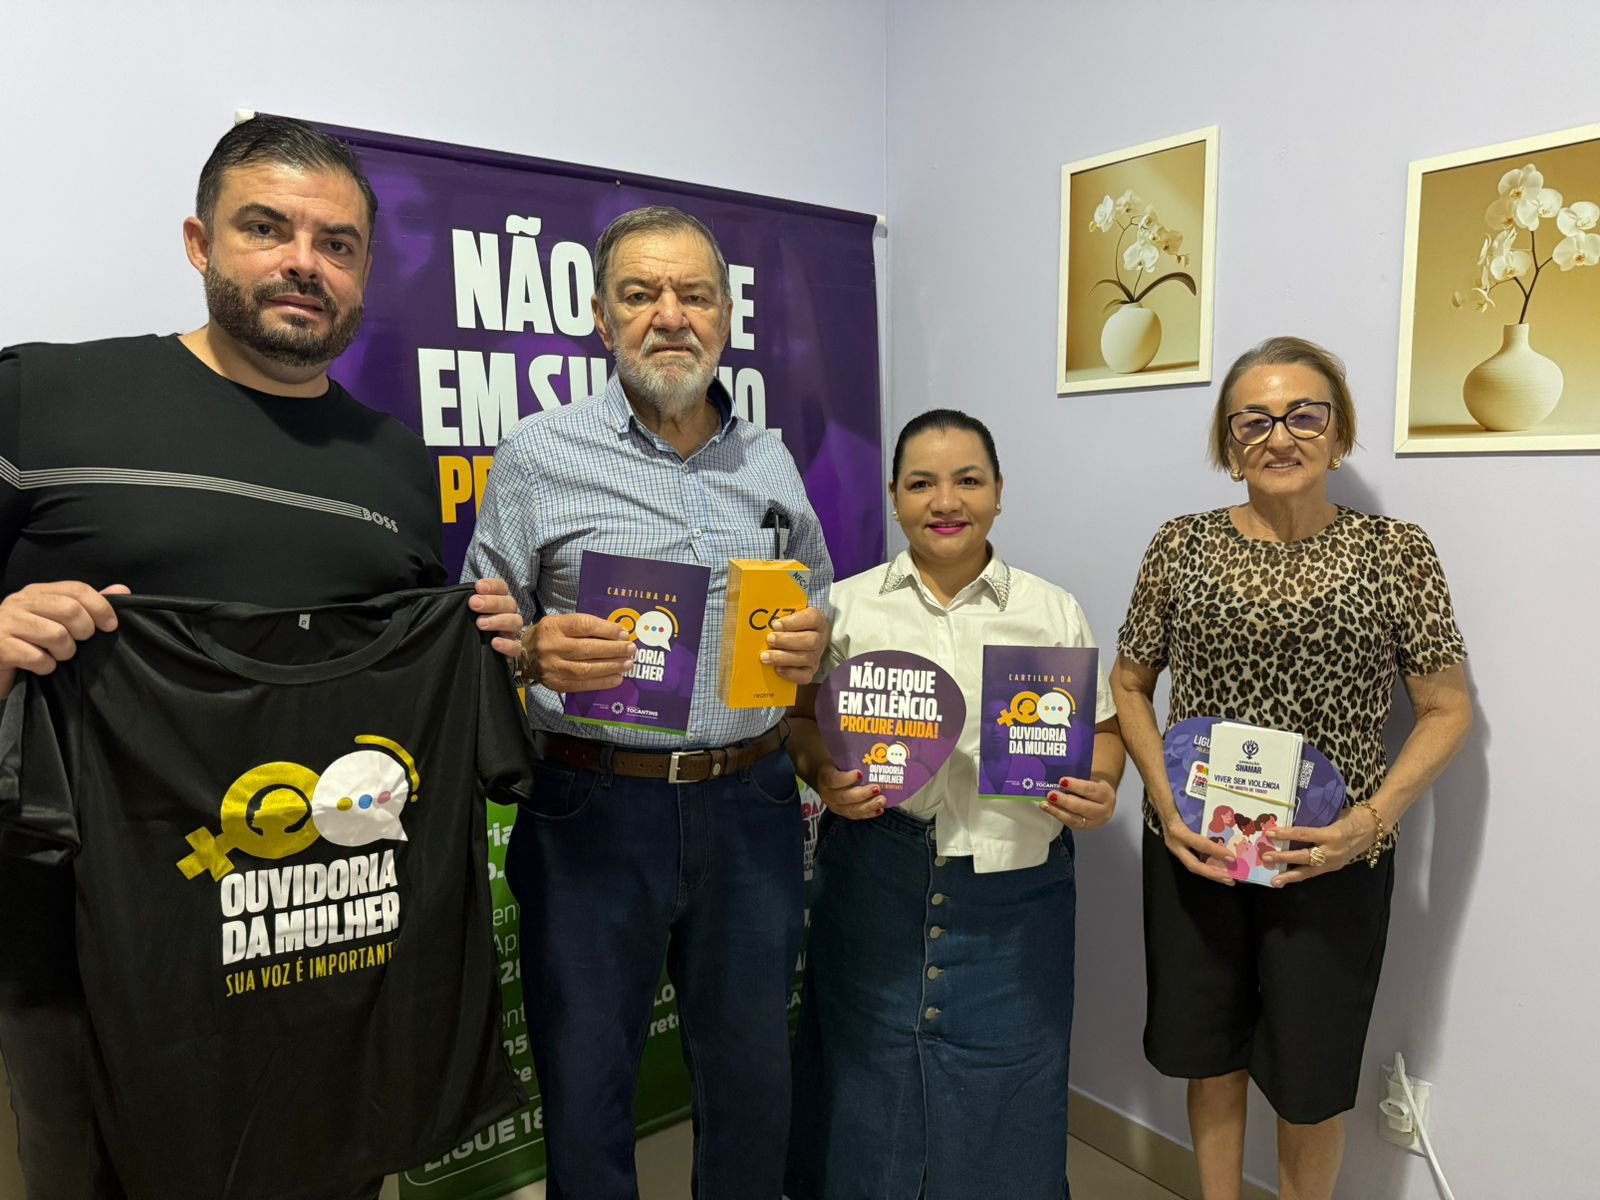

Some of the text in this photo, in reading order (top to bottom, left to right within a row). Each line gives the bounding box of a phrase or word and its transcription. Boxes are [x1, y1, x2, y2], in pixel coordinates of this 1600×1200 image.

[452, 214, 596, 337] NÃO
[418, 348, 520, 447] EM
[363, 507, 398, 533] BOSS
[607, 587, 677, 603] CARTILHA DA
[632, 648, 665, 667] DORIA
[849, 661, 936, 697] NÃO FIQUE
[1009, 673, 1072, 683] CARTILHA DA
[838, 691, 943, 722] EM SILÊNCIO.
[840, 715, 940, 739] PROCURE AJUDA!
[1009, 726, 1067, 742] OUVIDORIA
[1009, 741, 1067, 757] DA MULHER
[1193, 735, 1211, 750] LIGU
[869, 764, 904, 775] OUVIDORIA
[869, 773, 904, 784] DA MULHER
[1235, 764, 1262, 774] SHAMAR
[1214, 774, 1232, 784] VIVER
[1233, 777, 1246, 786] SEM
[1248, 780, 1280, 790] VIOLÊNCIA
[220, 848, 398, 917] OUVIDORIA
[222, 891, 400, 965] DA MULHER
[225, 940, 396, 997] SUA VOZ É IMPORTANT
